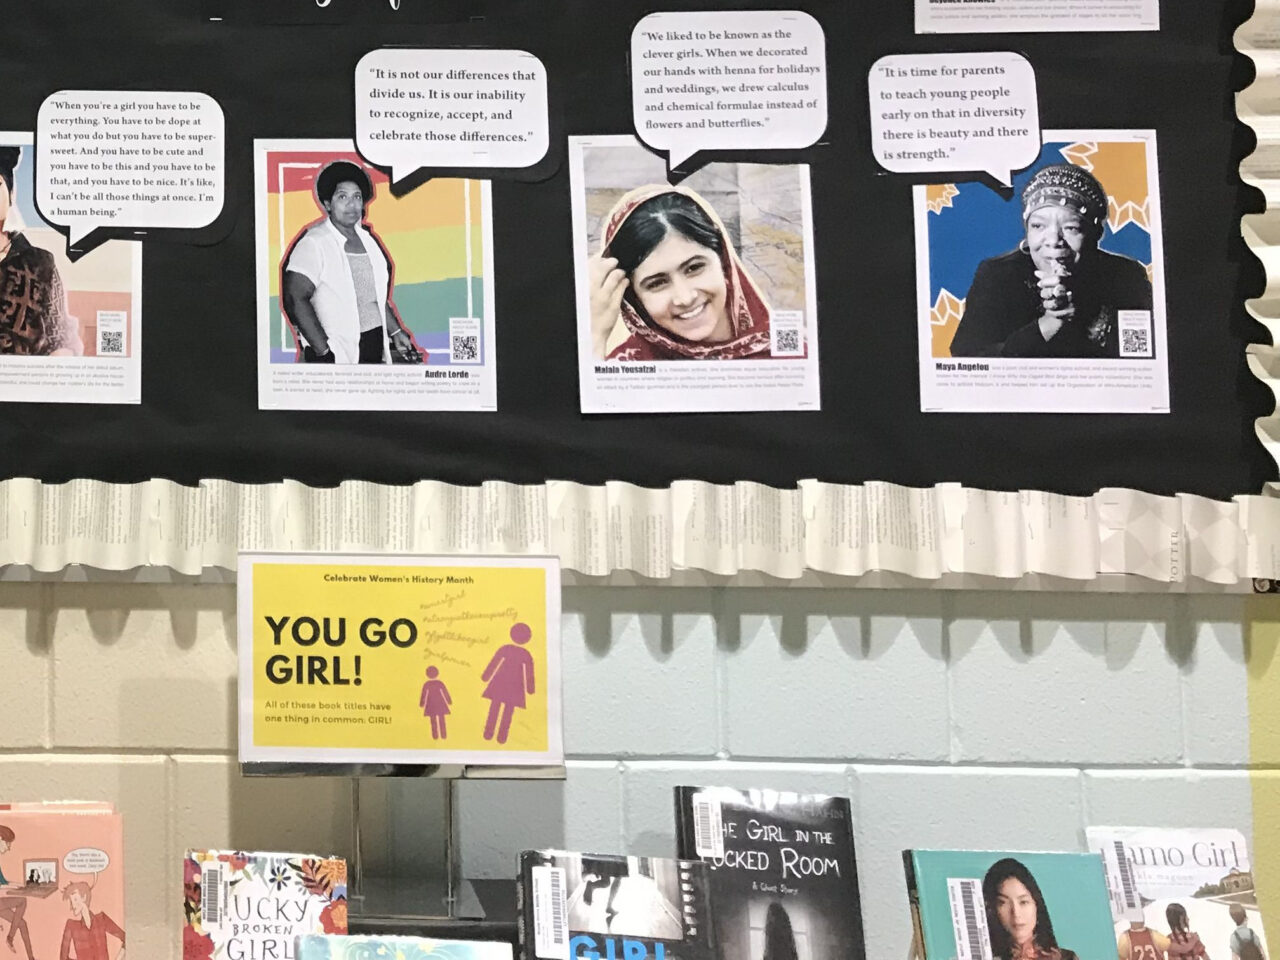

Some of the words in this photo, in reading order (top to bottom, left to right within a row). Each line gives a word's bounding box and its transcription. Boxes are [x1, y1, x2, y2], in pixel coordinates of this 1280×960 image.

[642, 49, 674, 58] clever
[676, 48, 703, 61] girls.
[705, 47, 737, 57] When
[756, 46, 808, 56] decorated
[881, 109, 911, 121] early
[931, 108, 955, 118] that
[958, 108, 970, 117] in
[973, 106, 1026, 119] diversity
[369, 129, 421, 140] celebrate
[424, 130, 456, 141] those
[57, 207, 87, 215] human
[425, 370, 447, 378] Audre
[448, 370, 469, 378] Lorde
[935, 363, 956, 372] Maya
[957, 363, 989, 372] Angelou
[323, 573, 366, 582] Celebrate
[368, 574, 409, 582] Women's
[411, 575, 443, 584] History
[445, 575, 474, 584] Month
[264, 616, 346, 647] YOU
[359, 617, 417, 648] GO
[265, 654, 362, 686] GIRL!
[264, 700, 277, 708] All
[279, 700, 289, 708] of
[291, 700, 316, 709] these
[318, 701, 340, 709] book
[344, 702, 367, 710] titles
[369, 702, 391, 710] have
[284, 714, 309, 724] thing
[311, 715, 320, 723] in
[367, 715, 392, 724] GIRL!
[722, 822, 737, 839] HE
[746, 819, 789, 842] GIRL
[794, 829, 809, 842] IN
[812, 831, 836, 845] THE
[712, 850, 769, 871] OCKED
[1192, 841, 1240, 867] Girl
[233, 894, 310, 922] UCKY
[233, 923, 294, 936] BROKEN
[227, 938, 295, 960] GIRL
